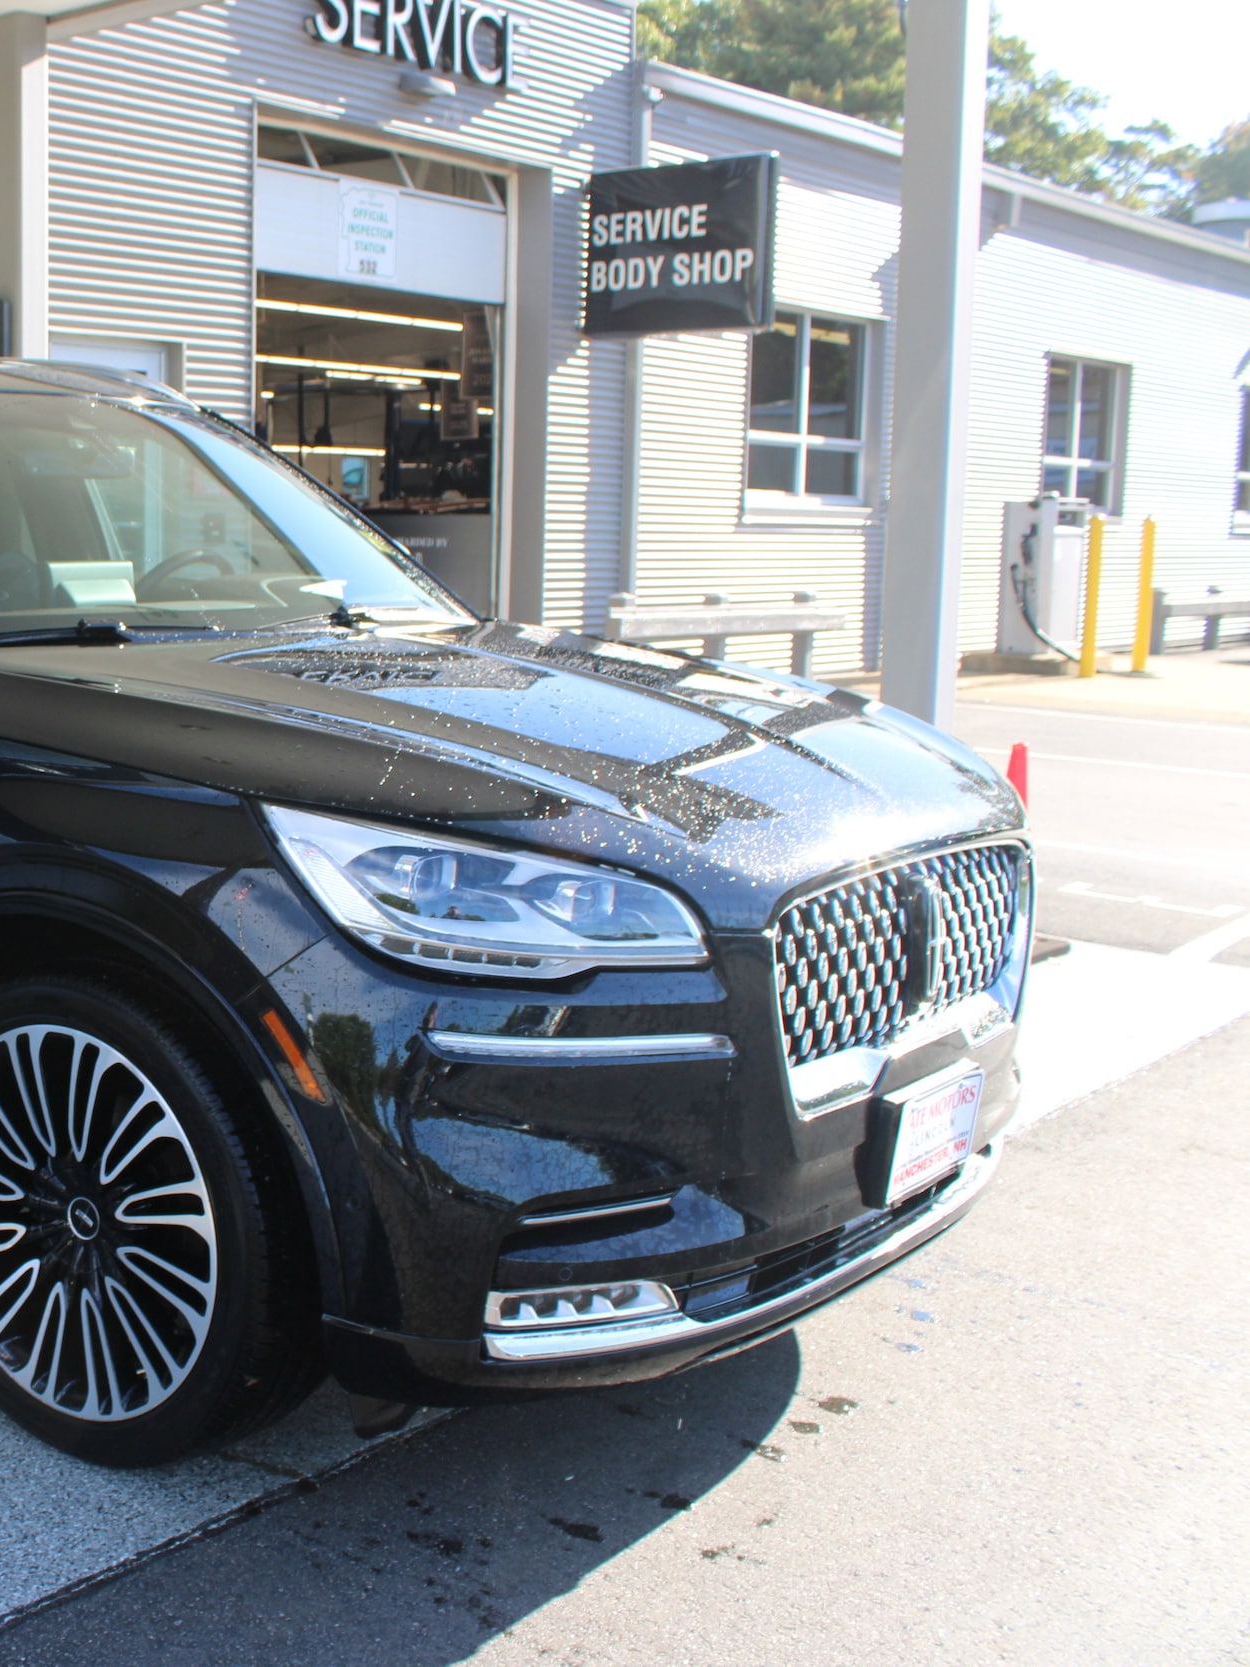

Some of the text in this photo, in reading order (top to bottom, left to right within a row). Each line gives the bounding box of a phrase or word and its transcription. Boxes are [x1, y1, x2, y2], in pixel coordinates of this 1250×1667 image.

[313, 0, 529, 89] SERVICE
[353, 208, 388, 223] OFFICIAL
[592, 203, 708, 247] SERVICE
[348, 224, 393, 239] INSPECTION
[355, 240, 387, 255] STATION
[590, 247, 754, 293] BODY SHOP
[929, 1085, 977, 1119] MOTORS
[953, 1138, 968, 1153] NH
